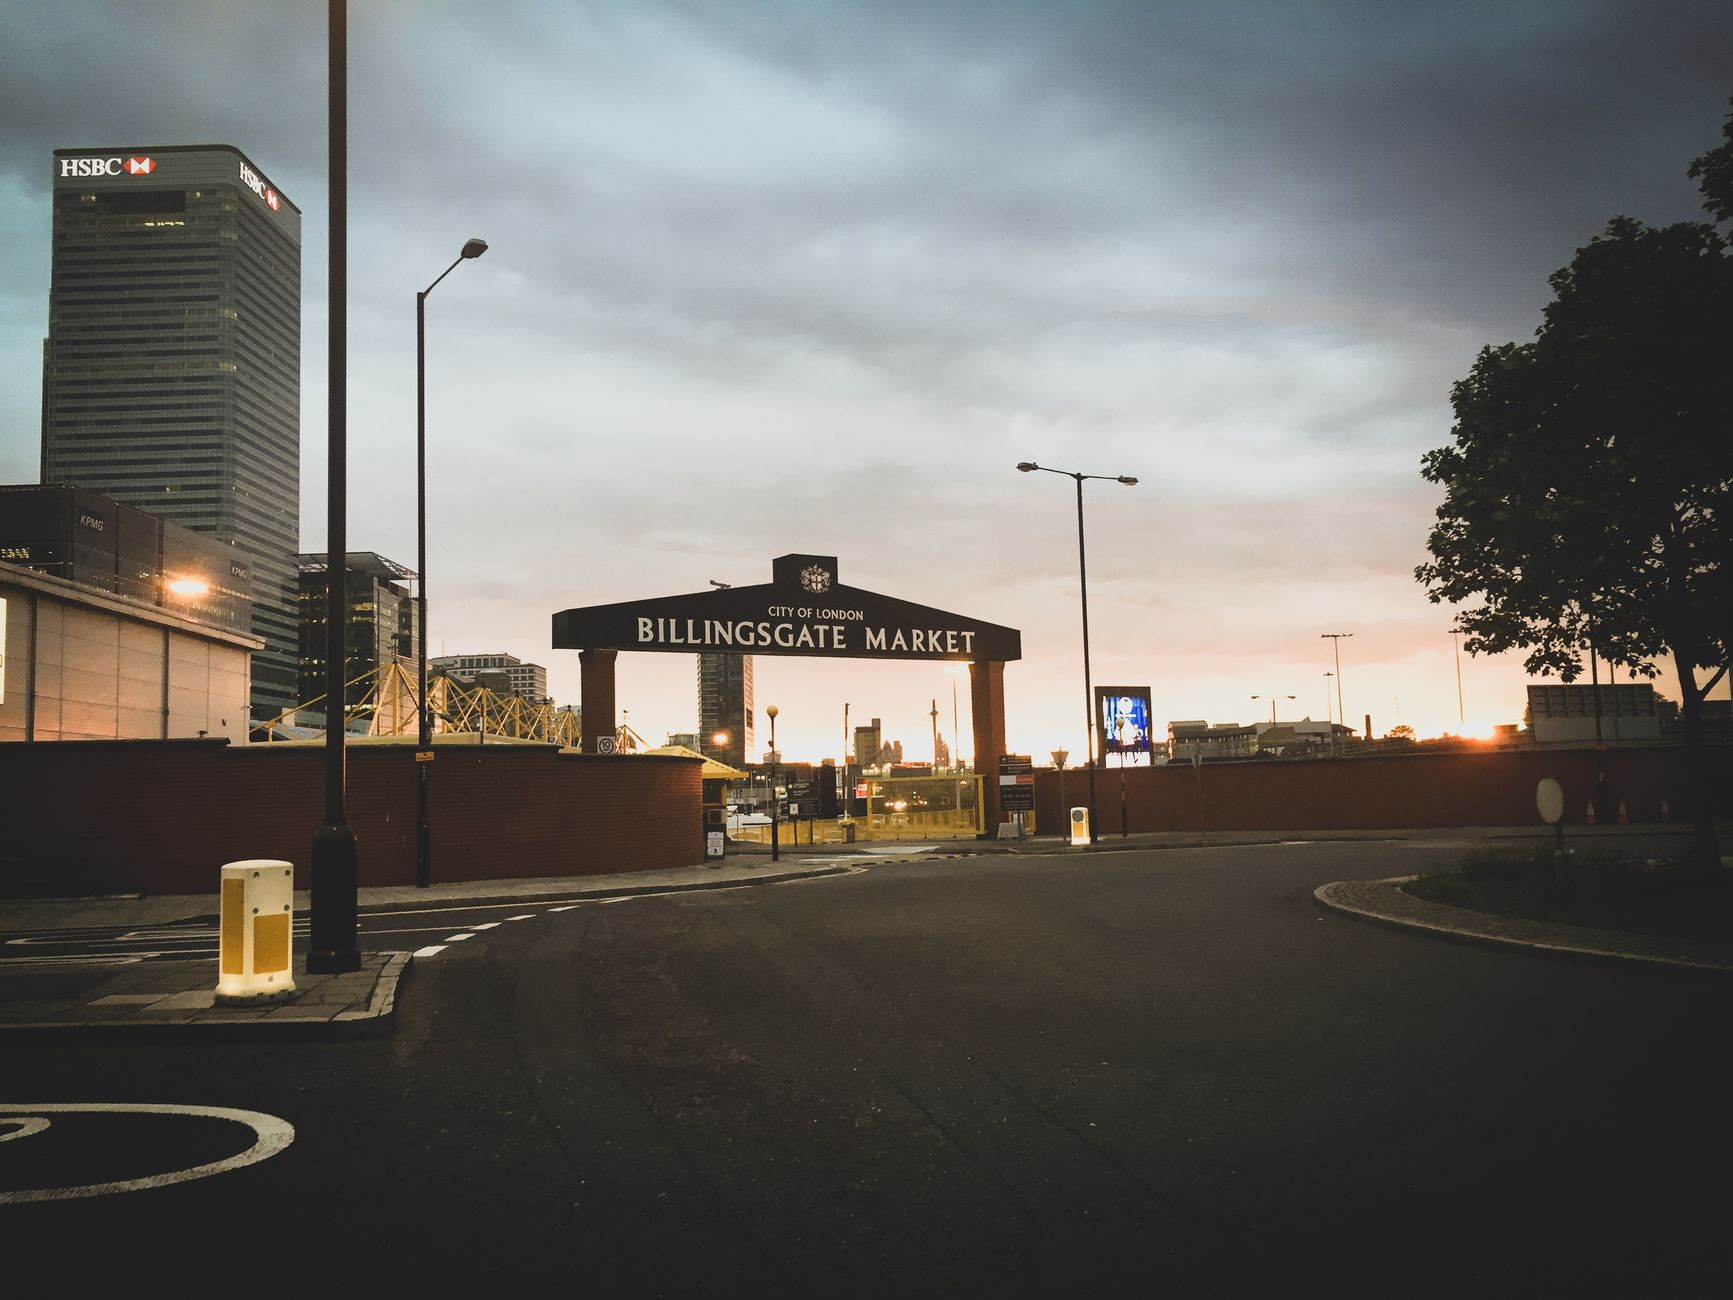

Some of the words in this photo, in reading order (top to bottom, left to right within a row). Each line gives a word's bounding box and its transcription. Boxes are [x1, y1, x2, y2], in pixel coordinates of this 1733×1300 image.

[61, 158, 122, 177] HSBC
[239, 161, 266, 200] HSBC
[80, 514, 104, 532] KPMG
[231, 566, 248, 580] KPMG
[768, 606, 795, 618] CITY
[797, 607, 813, 619] OF
[817, 608, 864, 621] LONDON
[637, 617, 847, 649] BILLINGSGATE
[865, 627, 976, 653] MARKET
